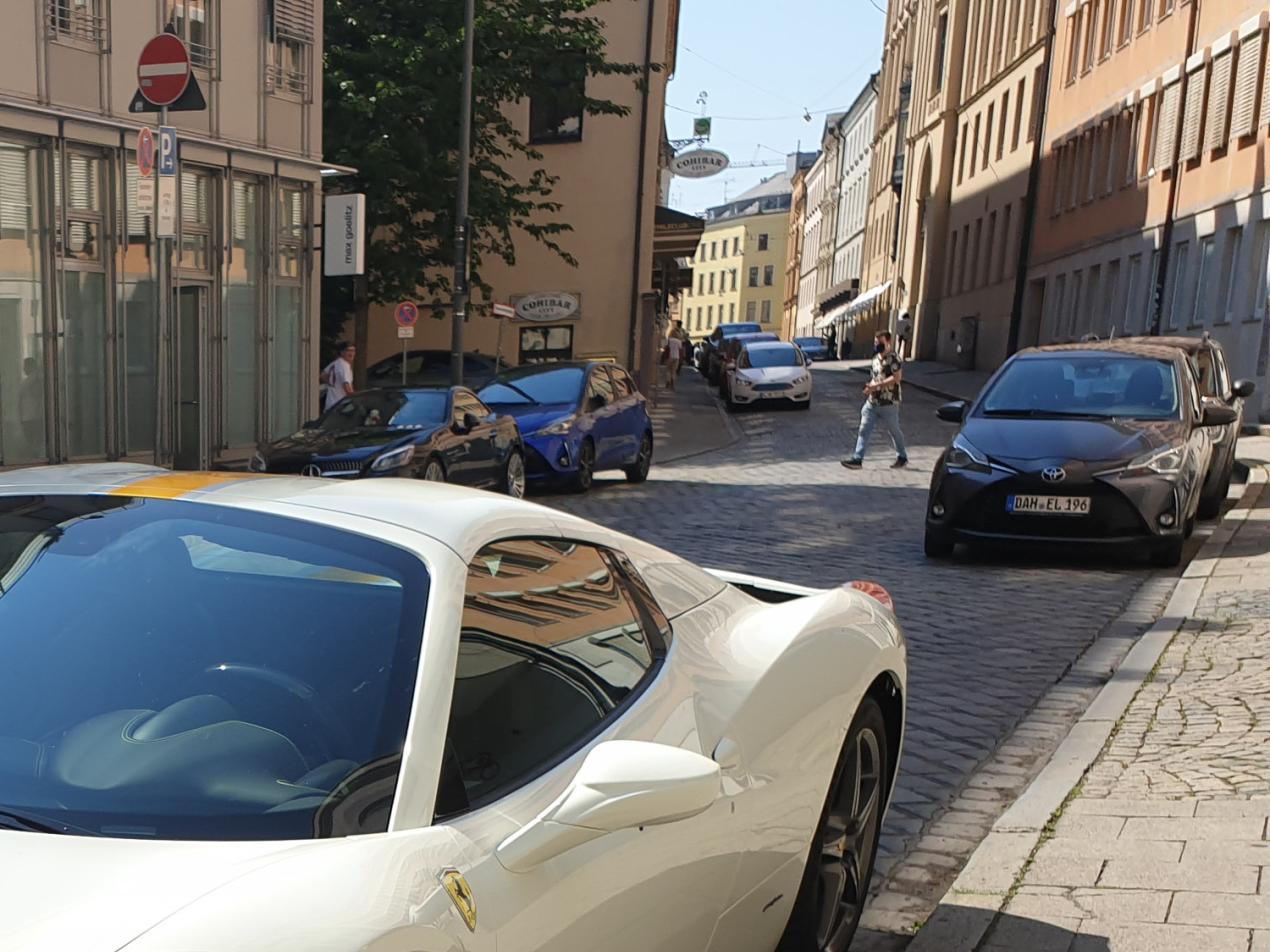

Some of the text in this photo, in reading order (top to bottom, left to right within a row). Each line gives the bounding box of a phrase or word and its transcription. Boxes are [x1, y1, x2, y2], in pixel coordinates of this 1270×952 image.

[161, 133, 172, 169] P
[676, 156, 723, 170] COHIBAR
[344, 205, 354, 239] goelitz
[1015, 497, 1088, 511] DAH EL 196
